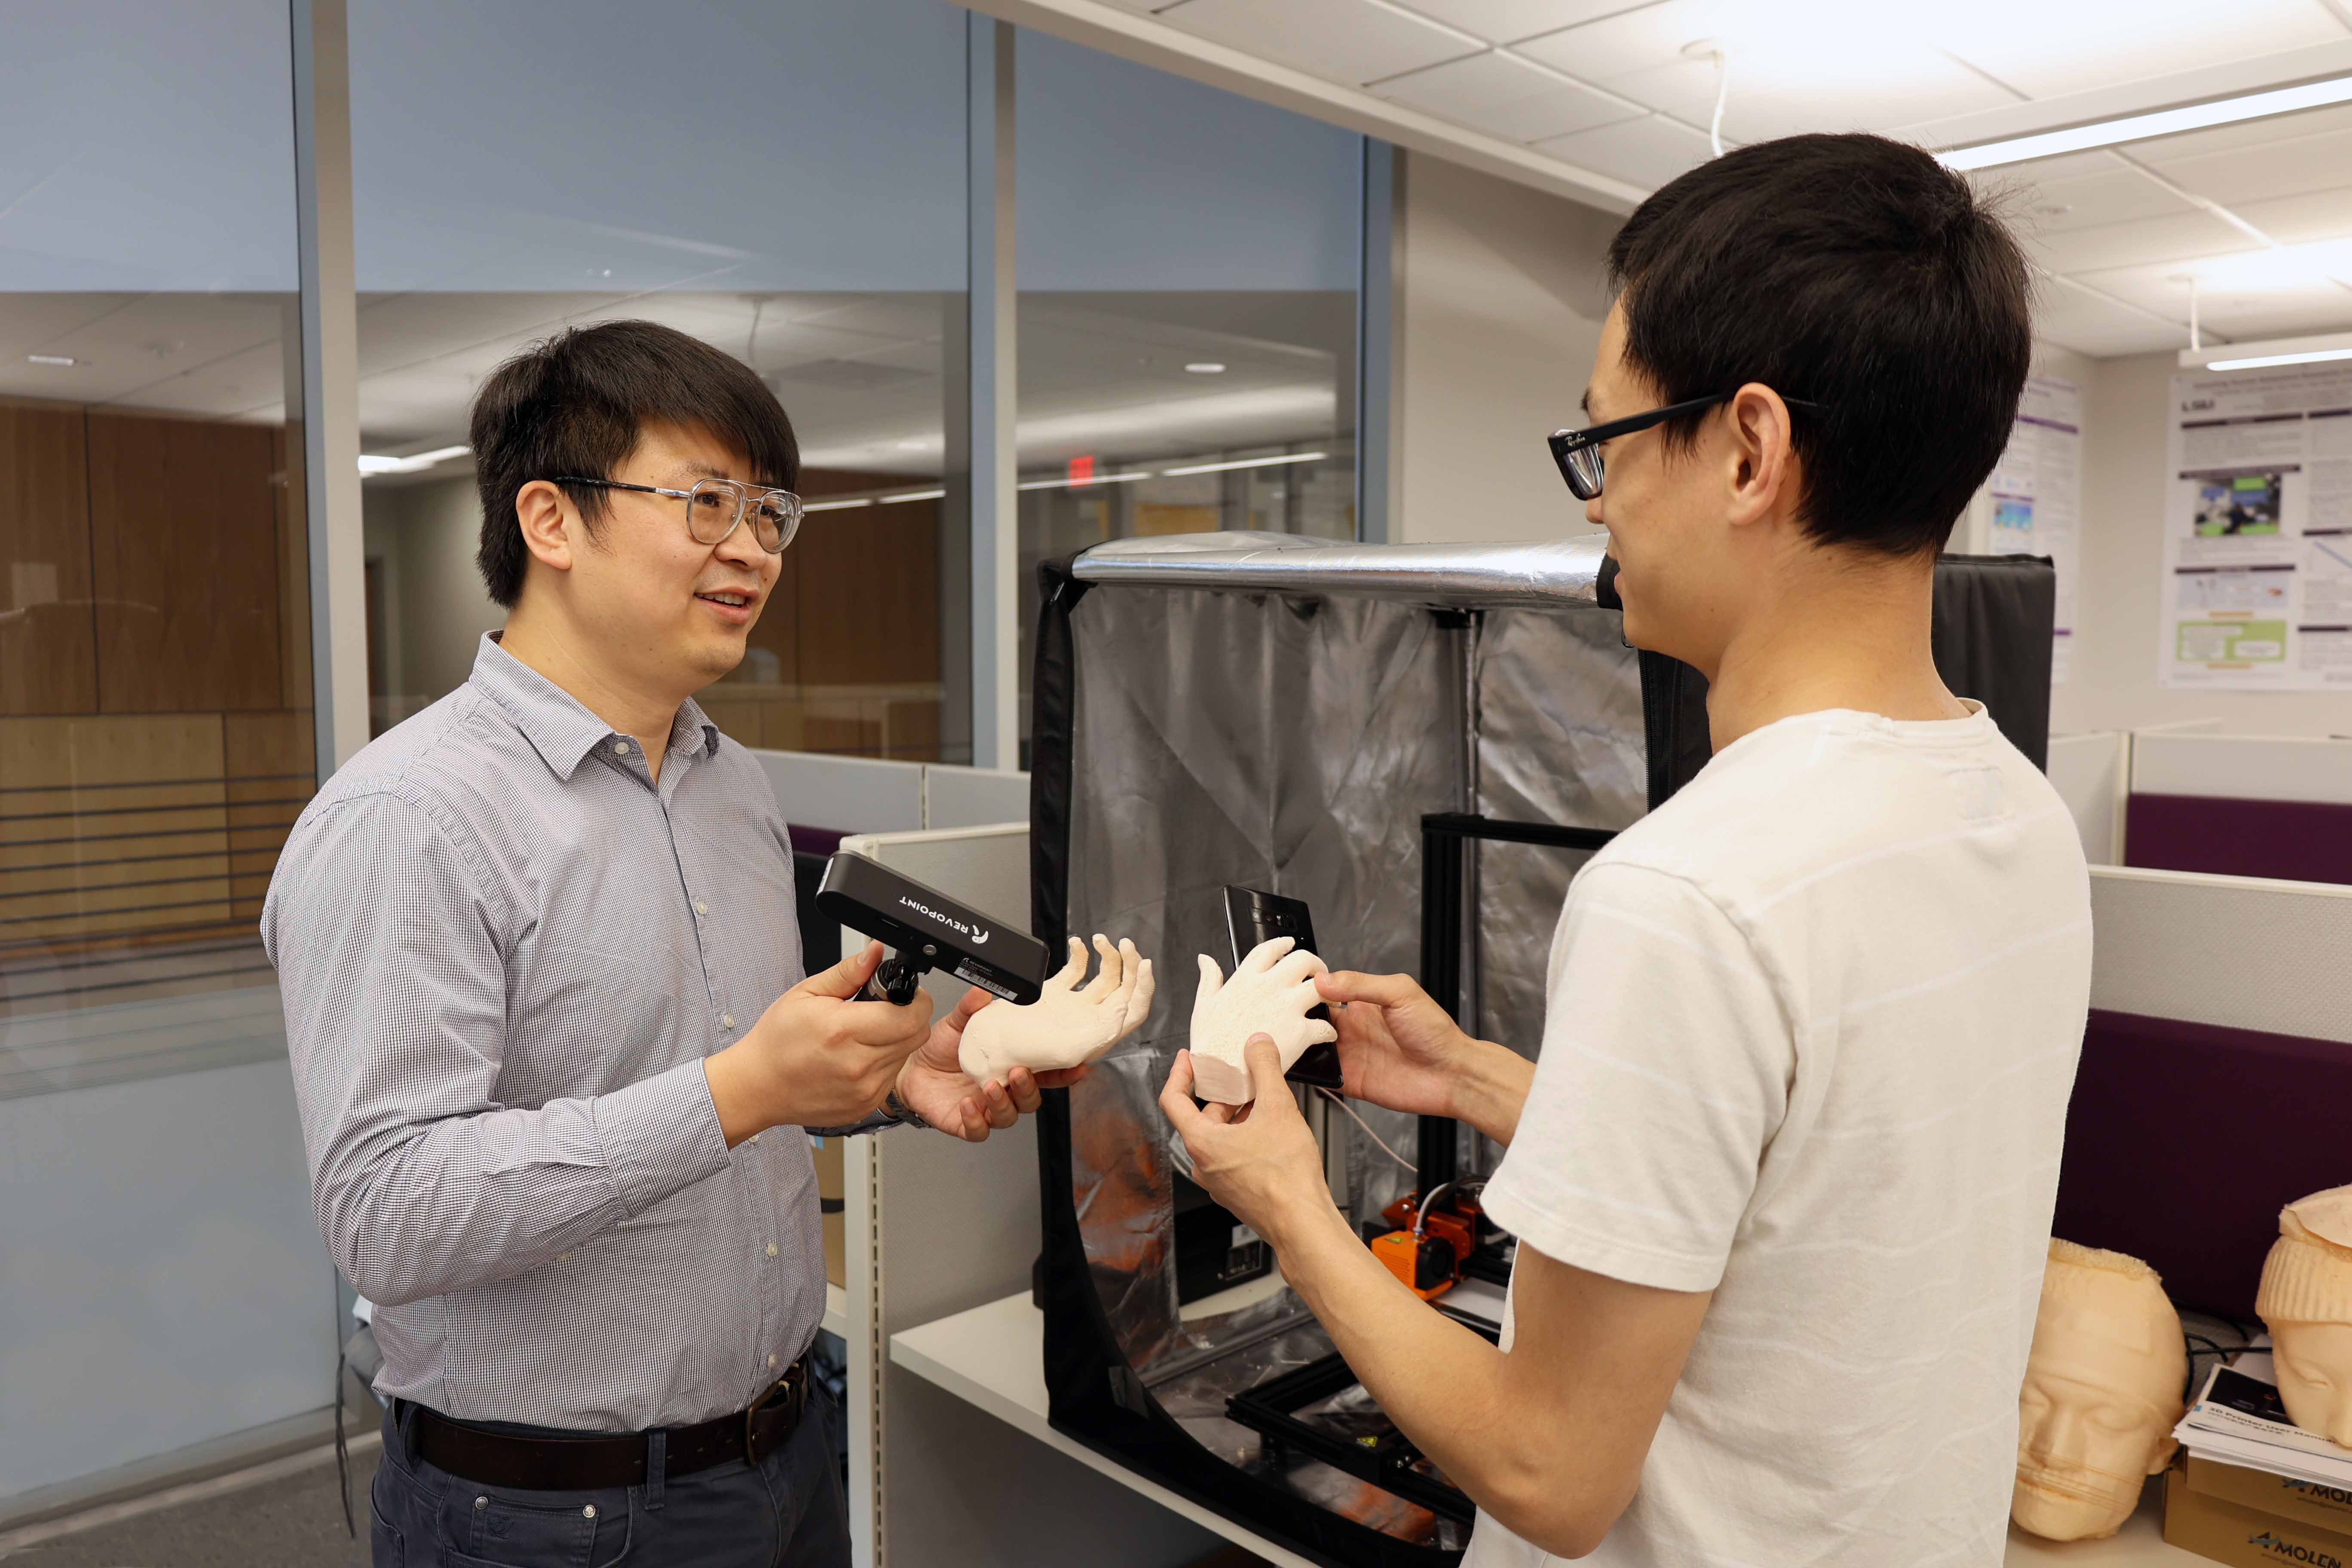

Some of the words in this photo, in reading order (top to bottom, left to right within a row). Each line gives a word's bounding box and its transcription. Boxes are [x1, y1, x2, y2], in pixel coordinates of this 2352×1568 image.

[899, 896, 969, 934] REVOPOINT
[2226, 1412, 2263, 1427] Printer
[2266, 1424, 2291, 1433] User
